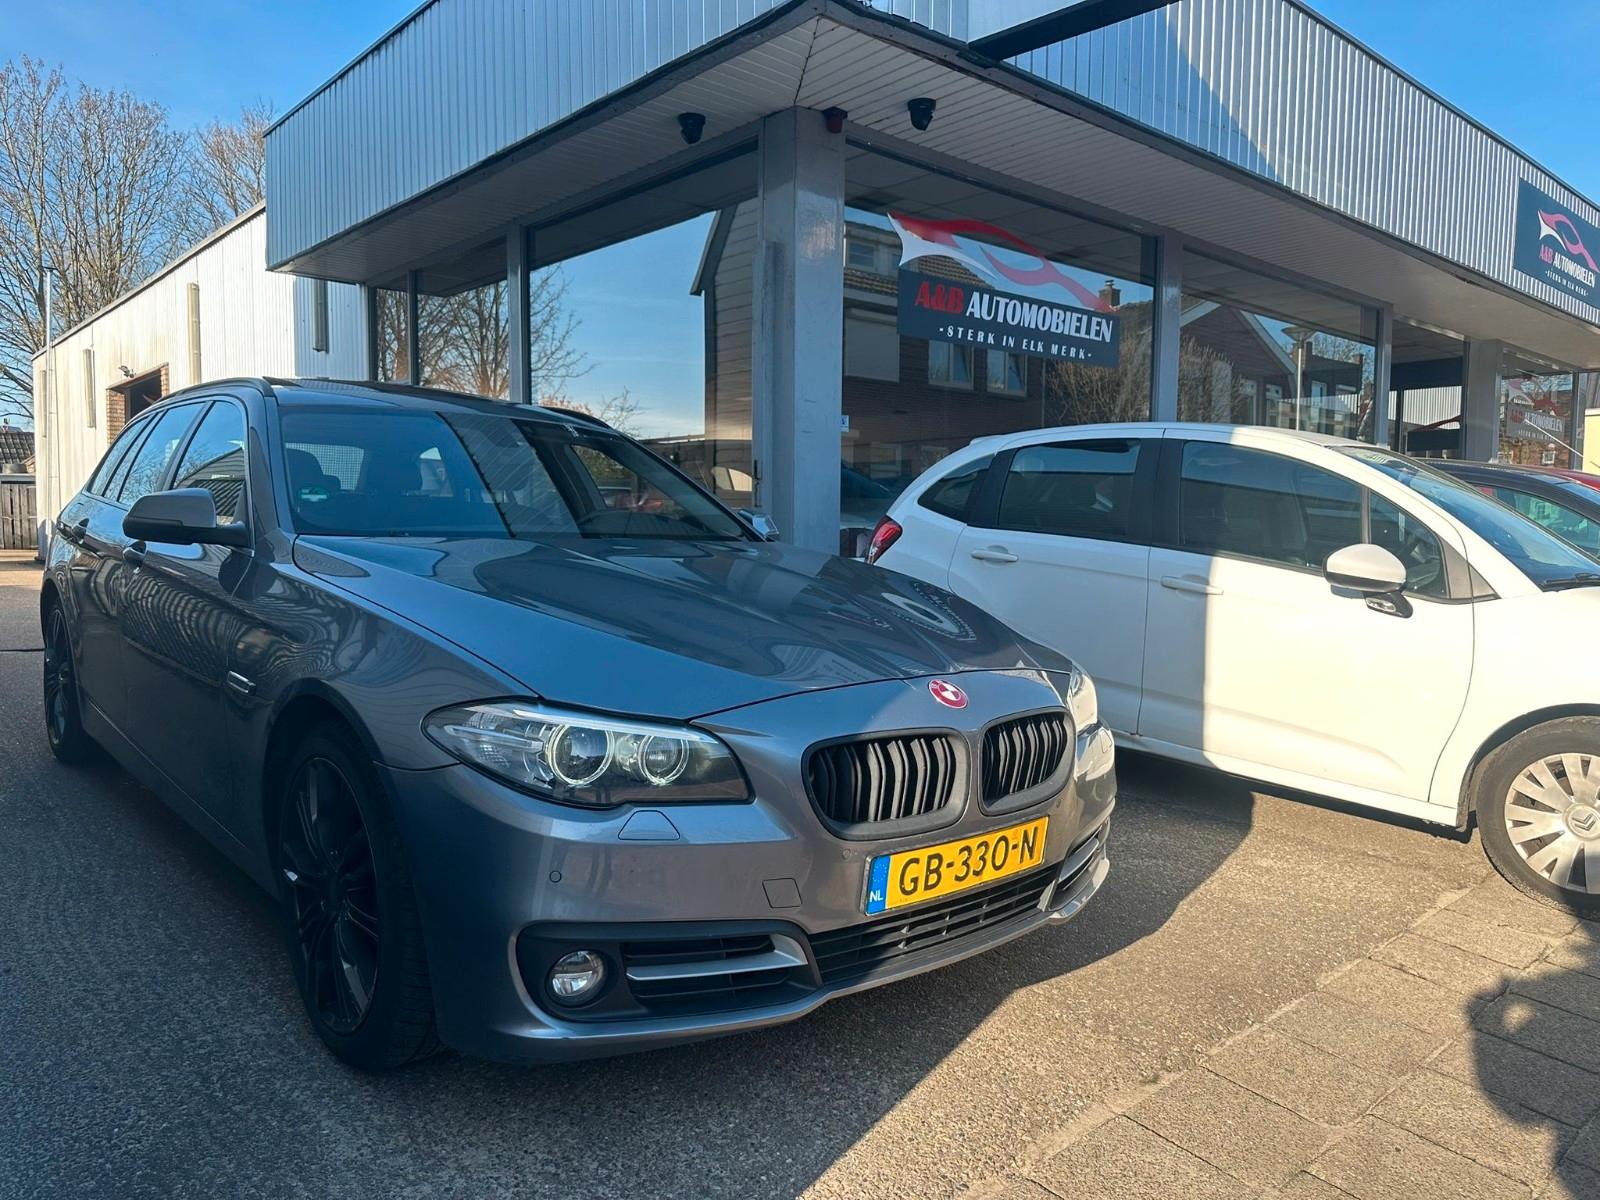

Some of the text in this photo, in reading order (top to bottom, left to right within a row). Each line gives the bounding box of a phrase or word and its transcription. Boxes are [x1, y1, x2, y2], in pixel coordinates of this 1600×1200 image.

[1553, 251, 1595, 288] AUTOMOBIELEN
[915, 280, 1113, 343] A&B AUTOMOBIELEN
[1003, 335, 1015, 348] IN
[1022, 339, 1044, 352] ELK
[899, 826, 1039, 896] GB-330-N
[869, 889, 883, 902] NL
